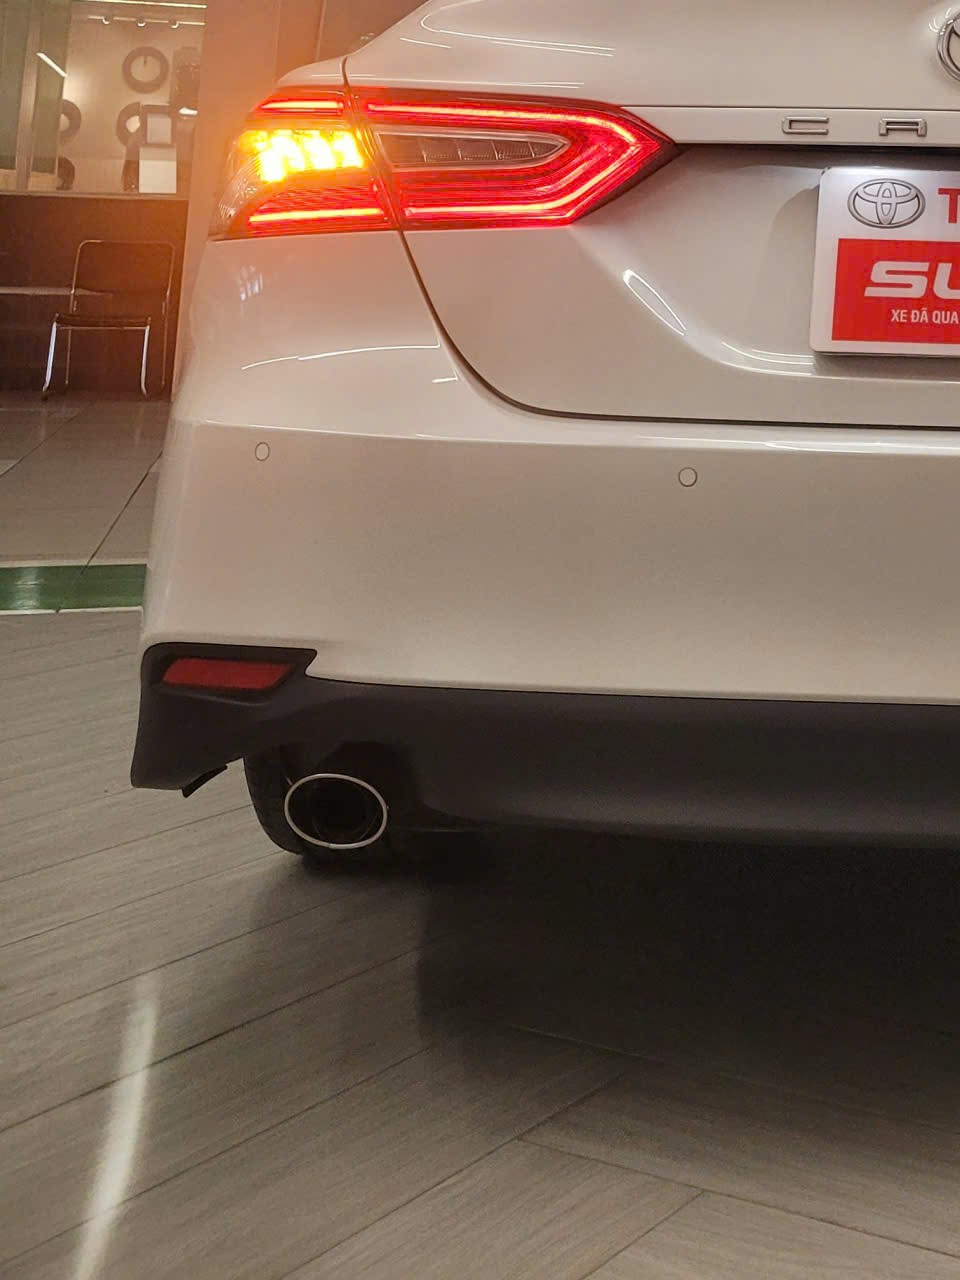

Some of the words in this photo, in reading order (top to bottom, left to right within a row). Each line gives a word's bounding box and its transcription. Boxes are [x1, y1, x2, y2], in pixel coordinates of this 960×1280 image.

[891, 309, 907, 322] XE
[911, 308, 928, 323] ĐÃ
[932, 310, 959, 325] QUA
